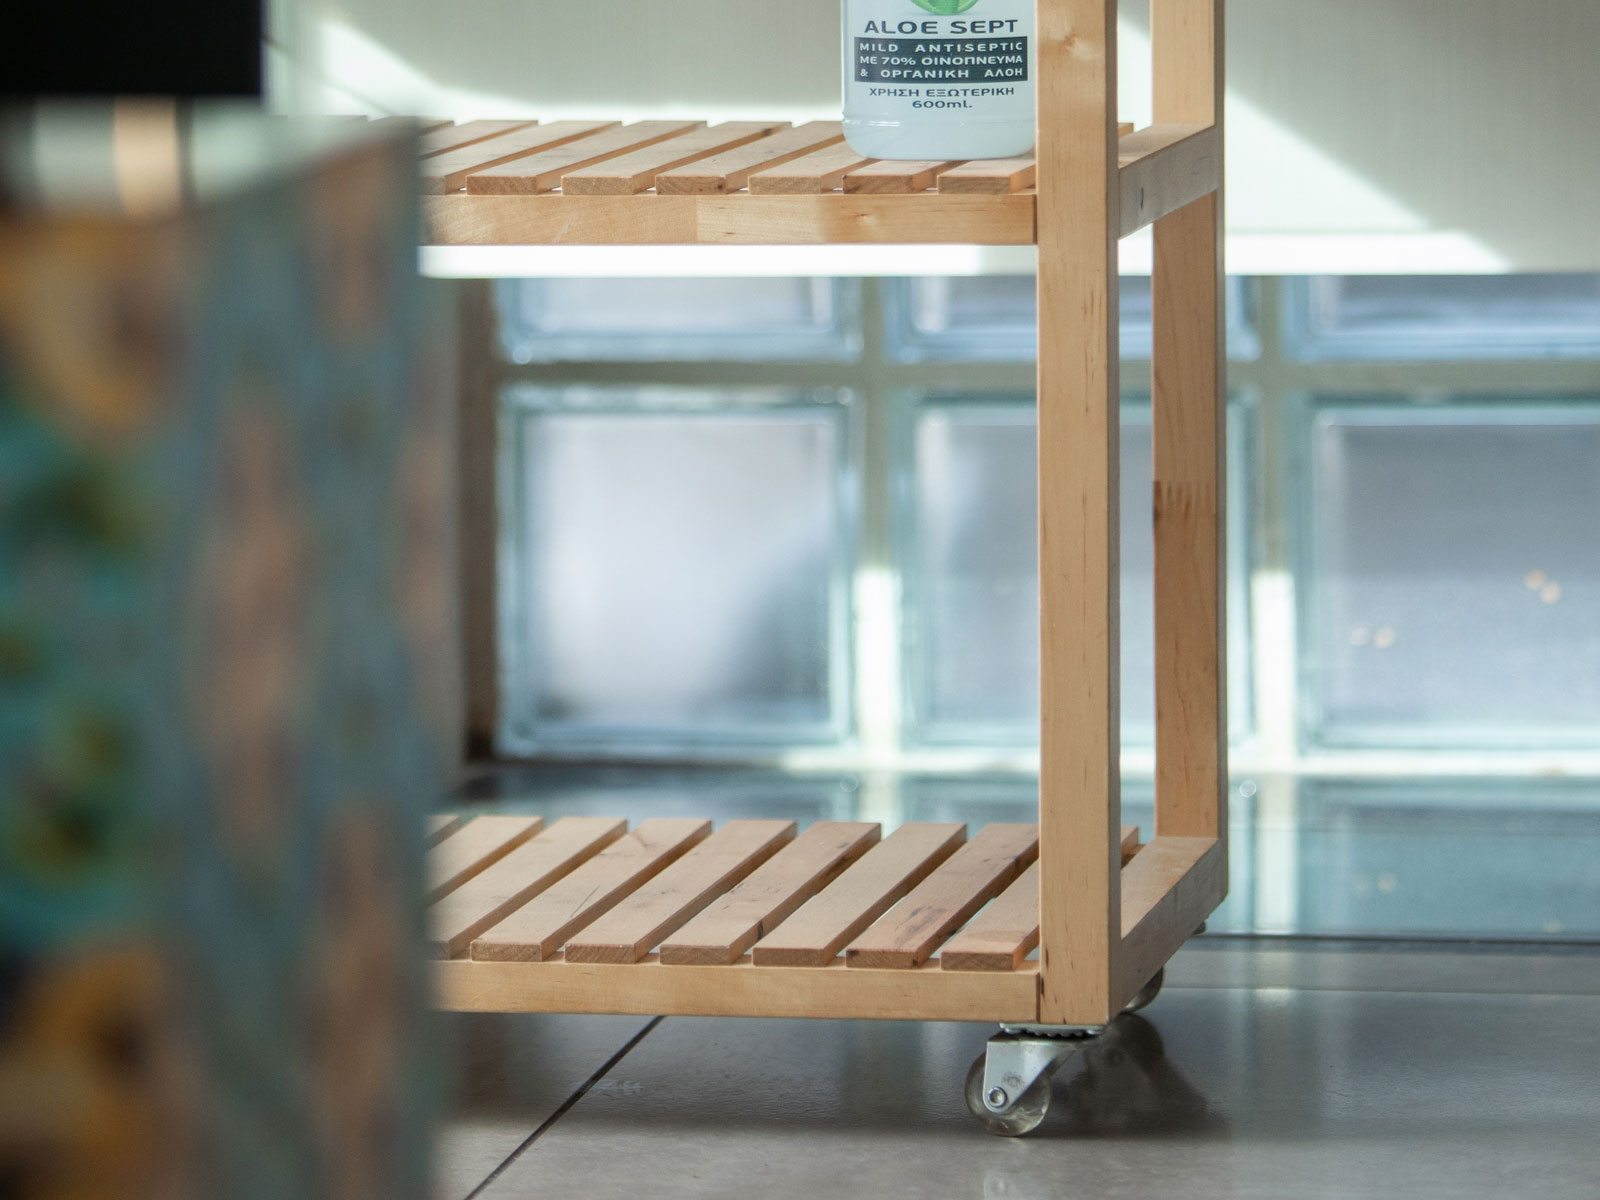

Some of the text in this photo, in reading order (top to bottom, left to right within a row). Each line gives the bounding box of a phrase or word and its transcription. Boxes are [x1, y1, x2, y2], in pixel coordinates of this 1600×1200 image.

[864, 19, 1018, 35] ALOE SEPT
[859, 42, 1023, 53] MILD ANTISEPTIC
[881, 56, 916, 66] 70%
[921, 55, 1023, 66] ΟΙΝΟΠΝΕΥΜΑ
[860, 68, 1023, 79] & ΟΡΓΑΝΙΚΗ ΑΛΟΗ
[869, 87, 1015, 98] ΧΡΗΣΗ ΕΞΩΤΕΡΙΚΗ
[912, 99, 973, 109] 600ml.
